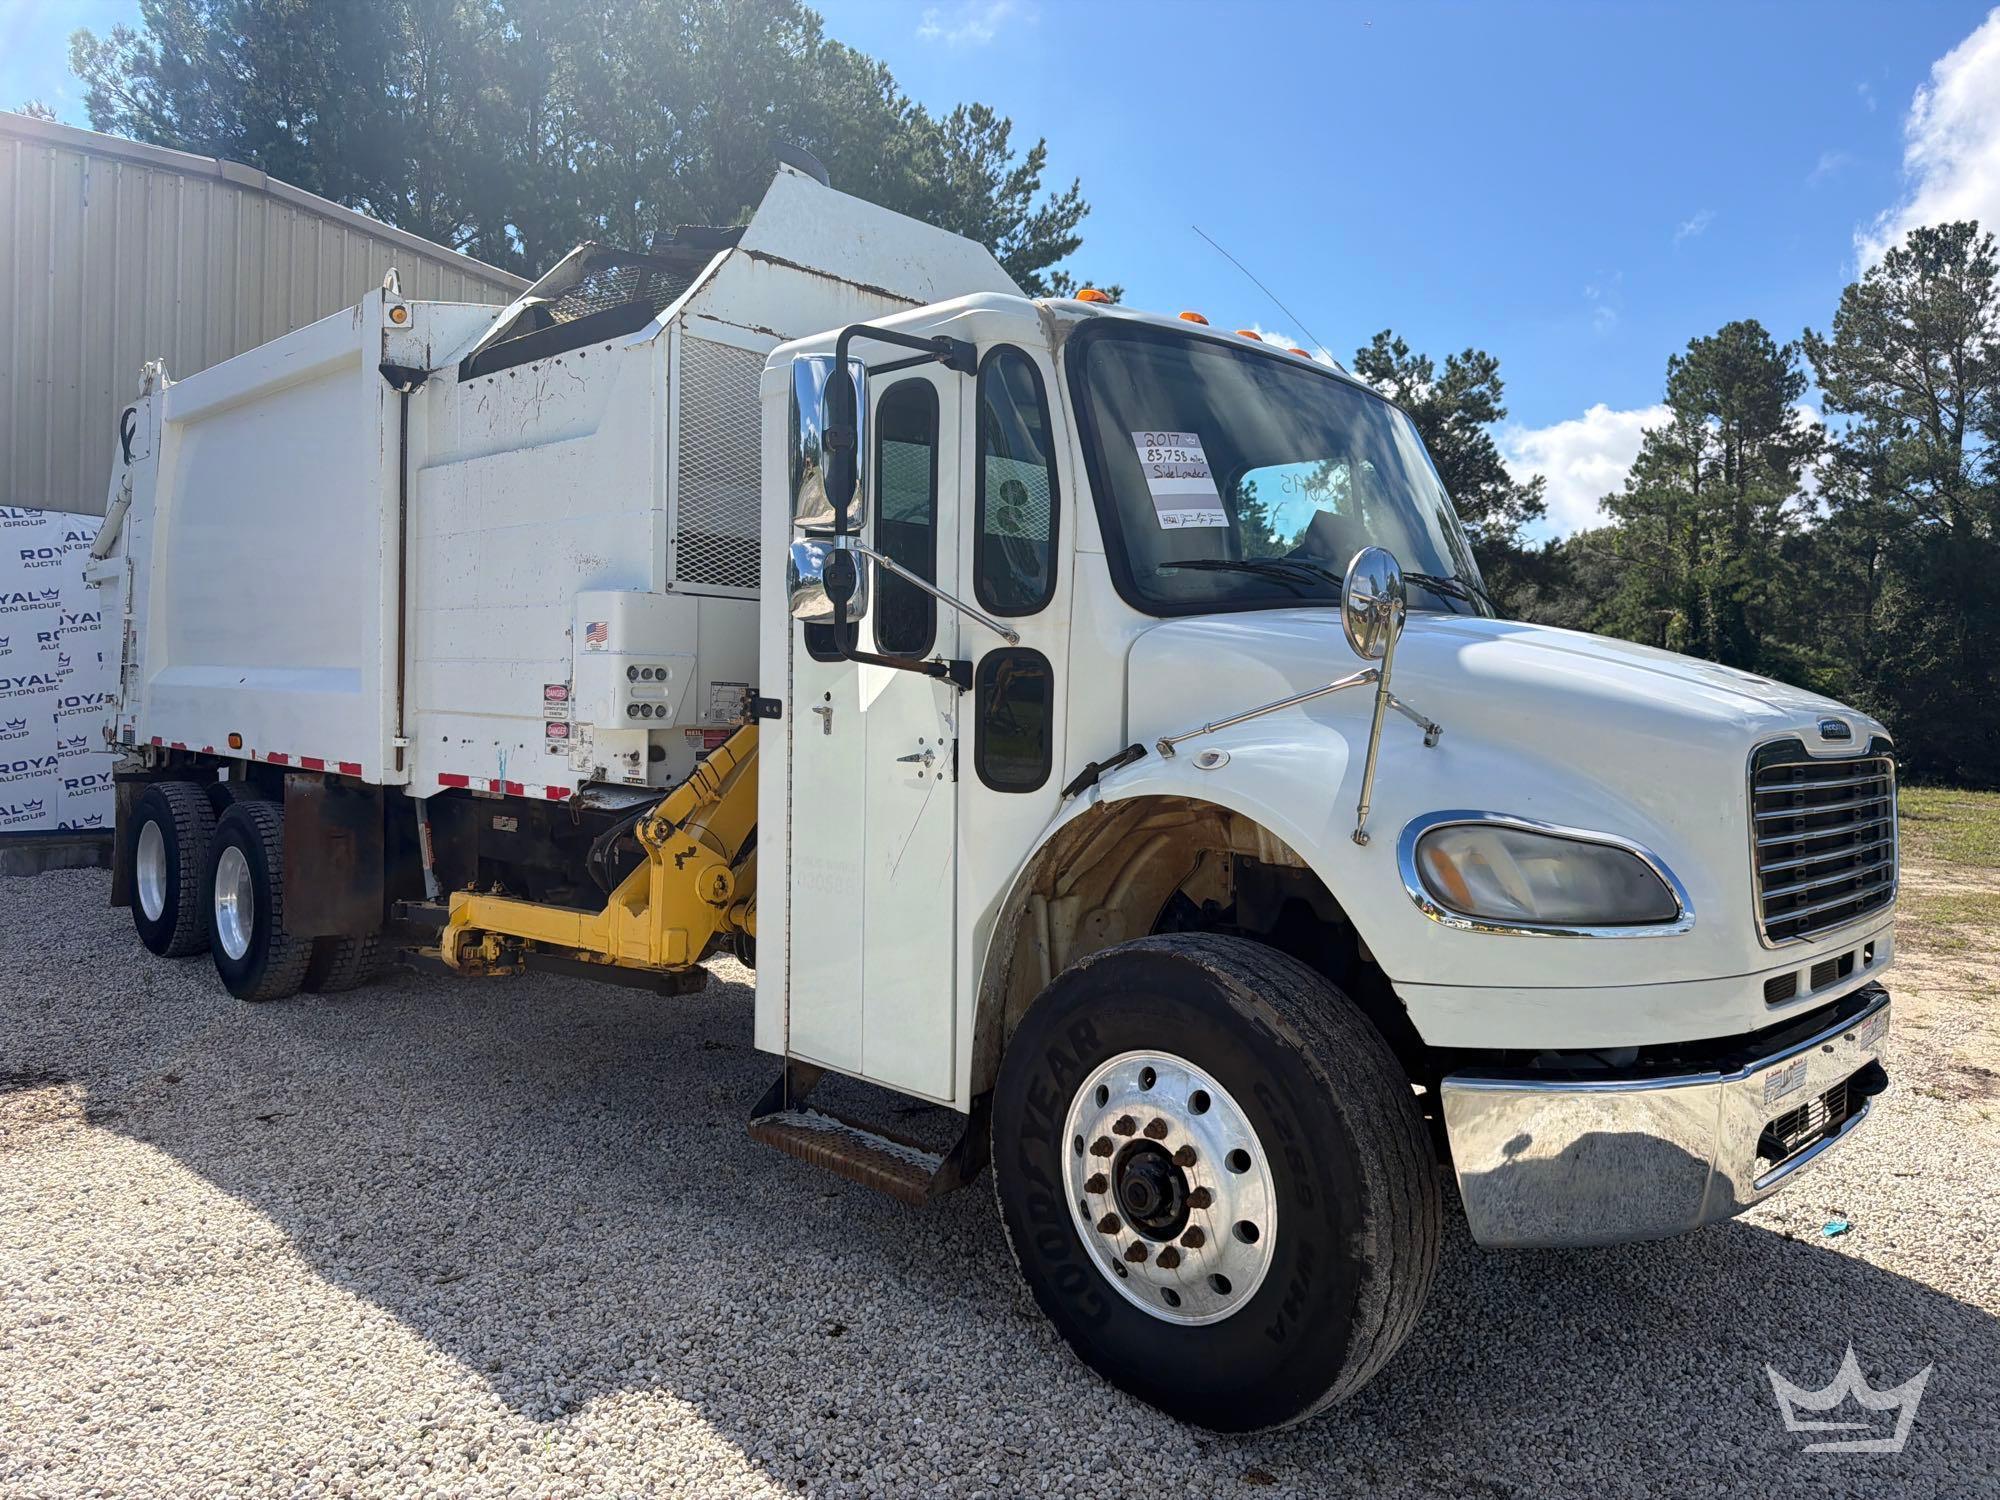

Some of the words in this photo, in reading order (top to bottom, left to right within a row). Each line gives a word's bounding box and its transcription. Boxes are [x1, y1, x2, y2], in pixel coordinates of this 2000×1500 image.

[1144, 433, 1180, 447] 2017
[1147, 449, 1188, 463] 85,758
[4, 519, 47, 528] GROUP
[545, 688, 568, 698] DANGER
[547, 726, 568, 736] DANGER
[4, 811, 47, 825] GROUP
[1018, 1017, 1114, 1329] GOODYEAR
